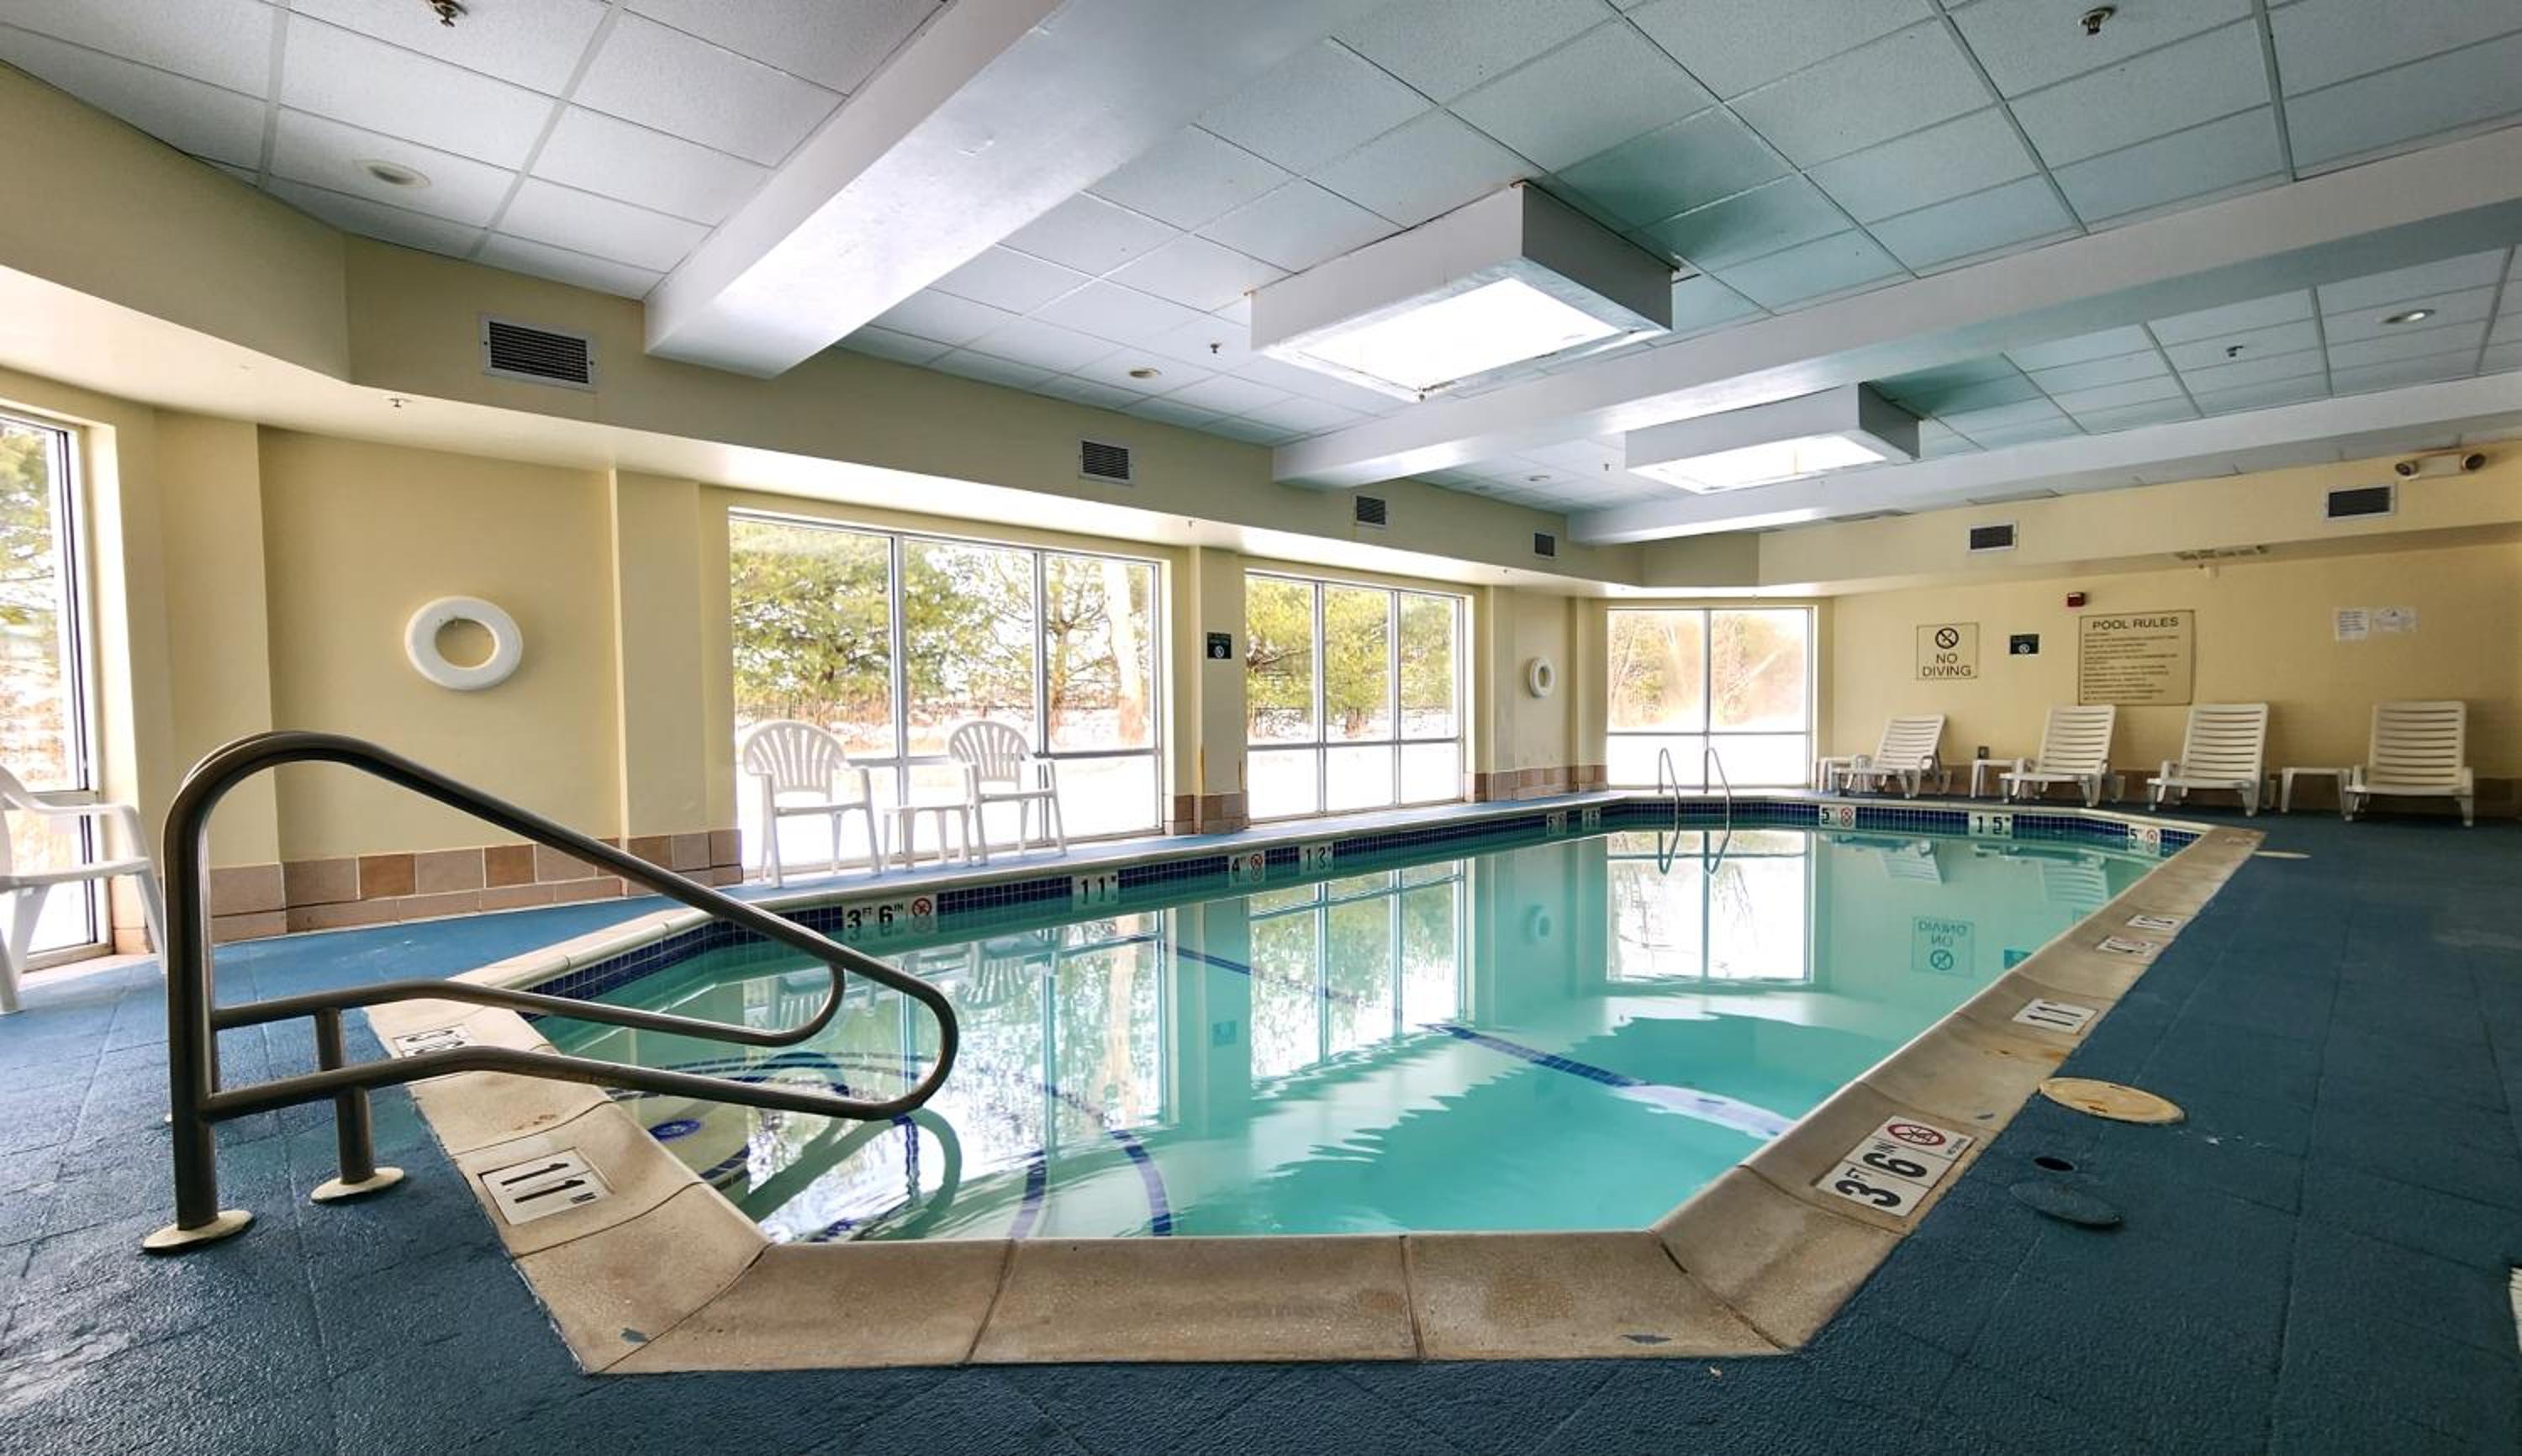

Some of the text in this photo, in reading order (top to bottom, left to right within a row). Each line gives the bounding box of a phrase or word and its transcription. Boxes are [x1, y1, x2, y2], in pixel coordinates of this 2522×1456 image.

[2092, 617, 2180, 630] POOL RULES
[1935, 653, 1959, 664] NO
[1923, 665, 1971, 677] DIVING
